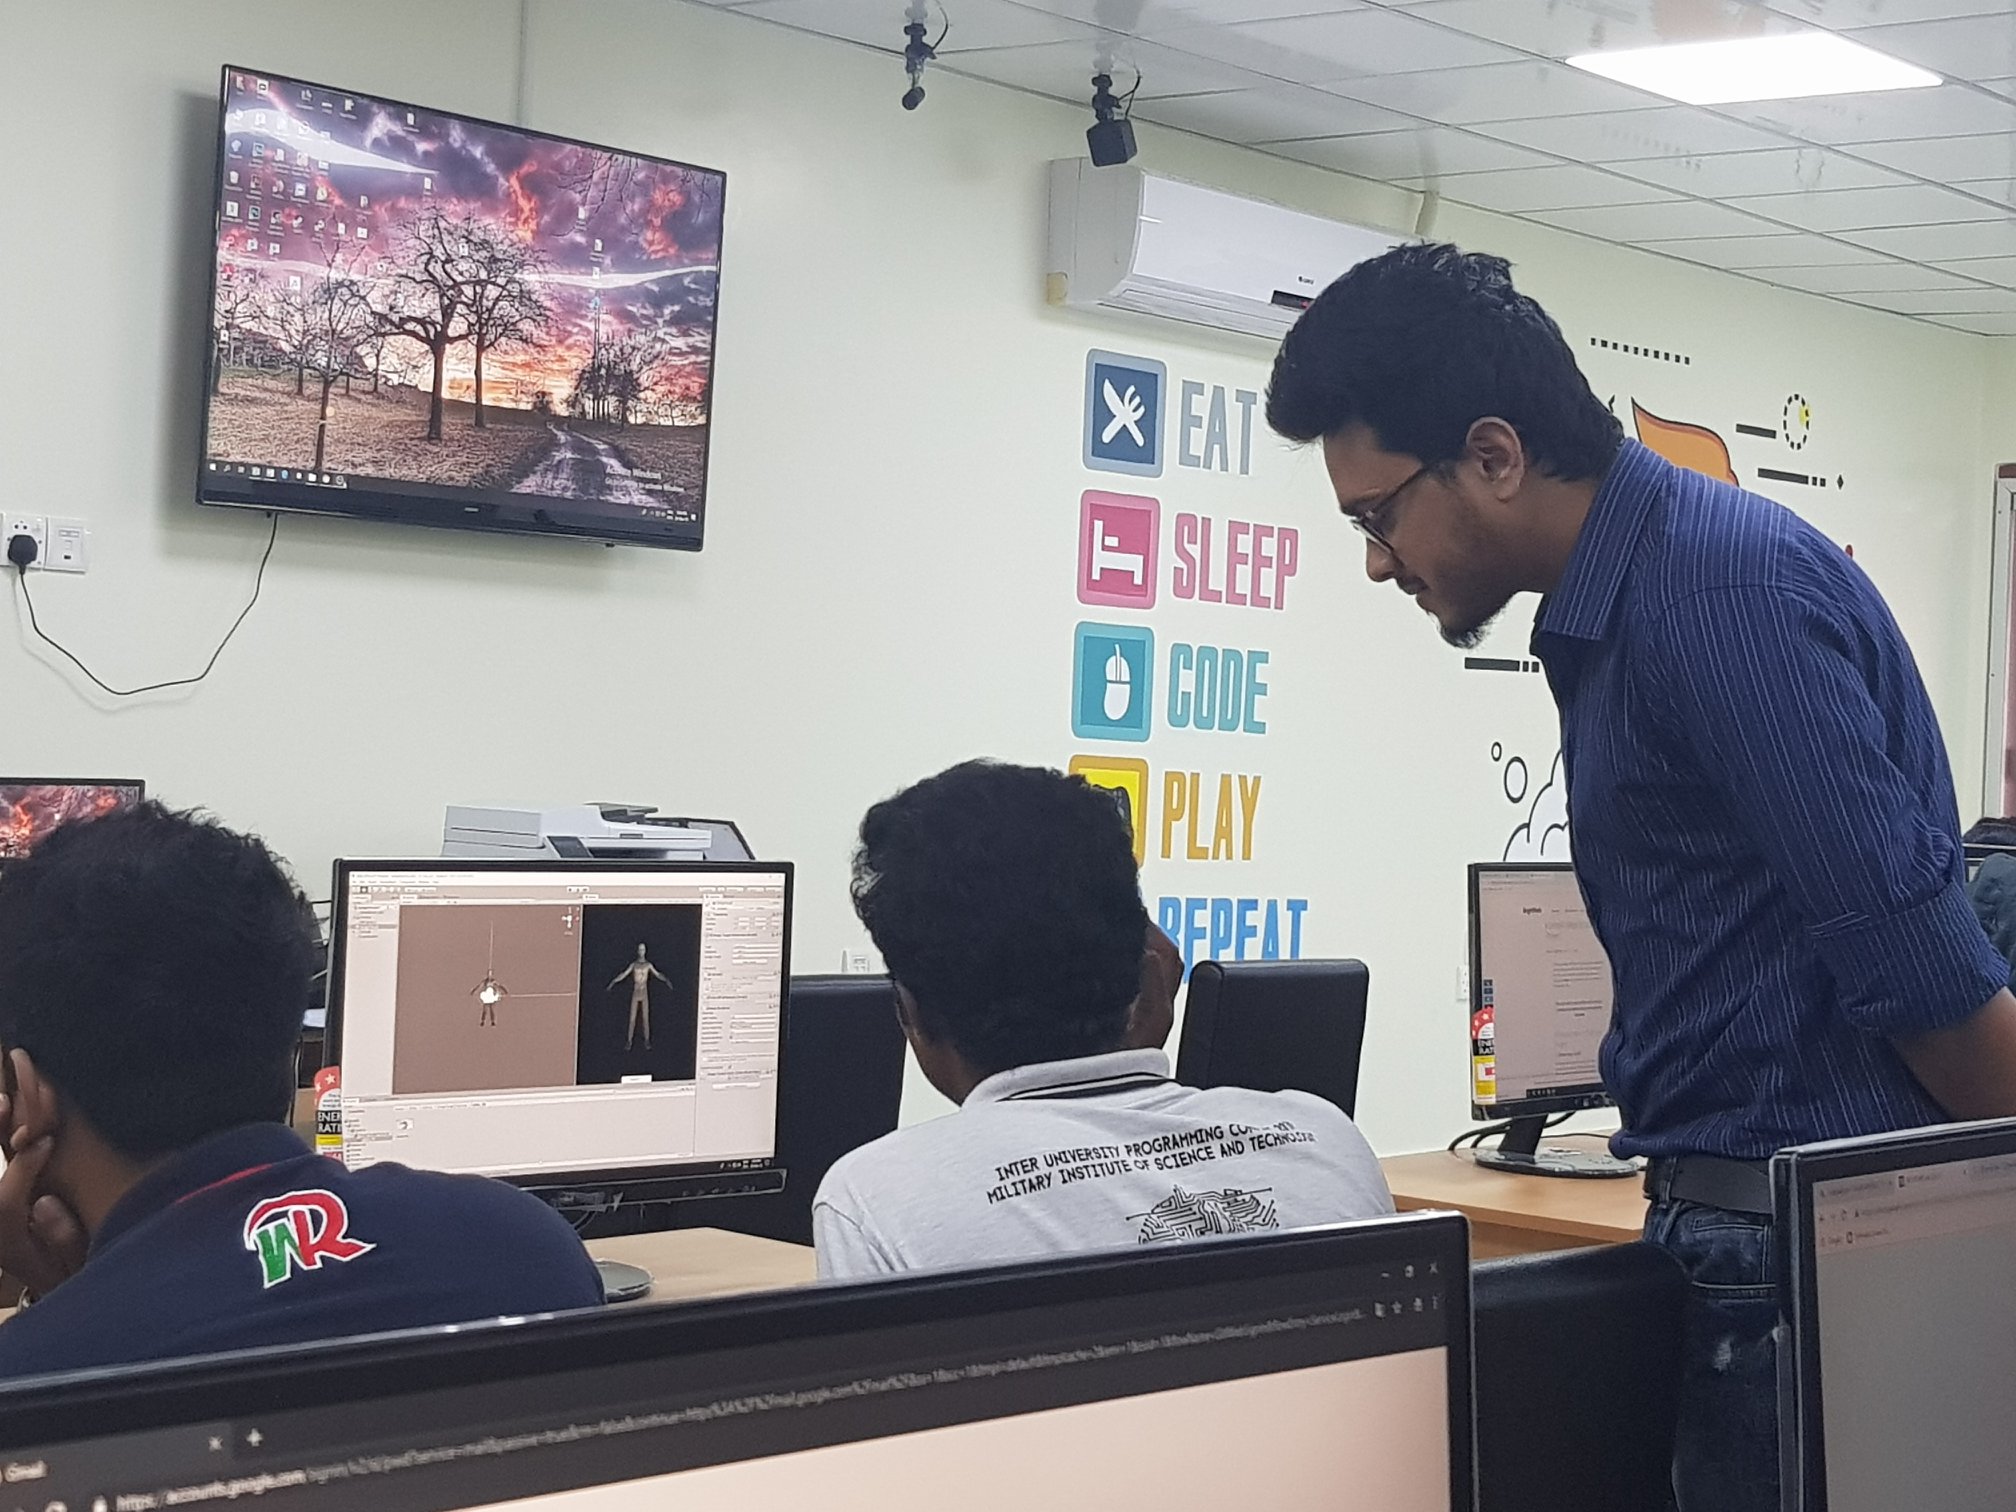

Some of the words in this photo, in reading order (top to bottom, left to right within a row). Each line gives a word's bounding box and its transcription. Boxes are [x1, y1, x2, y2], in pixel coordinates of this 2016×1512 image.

[1178, 378, 1257, 476] EAT
[1172, 511, 1299, 611] SLEEP
[1166, 642, 1269, 735] CODE
[1160, 770, 1262, 861] PLAY
[986, 1172, 1052, 1205] MILITARY
[1058, 1159, 1132, 1185] INSTITUTE
[1134, 1159, 1151, 1171] OF
[1154, 1145, 1216, 1171] SCIENCE
[1220, 1140, 1245, 1158] AND
[995, 1156, 1040, 1182] INTER
[1043, 1145, 1120, 1168] UNIVERSITY
[1124, 1125, 1224, 1158] PROGRAMMING
